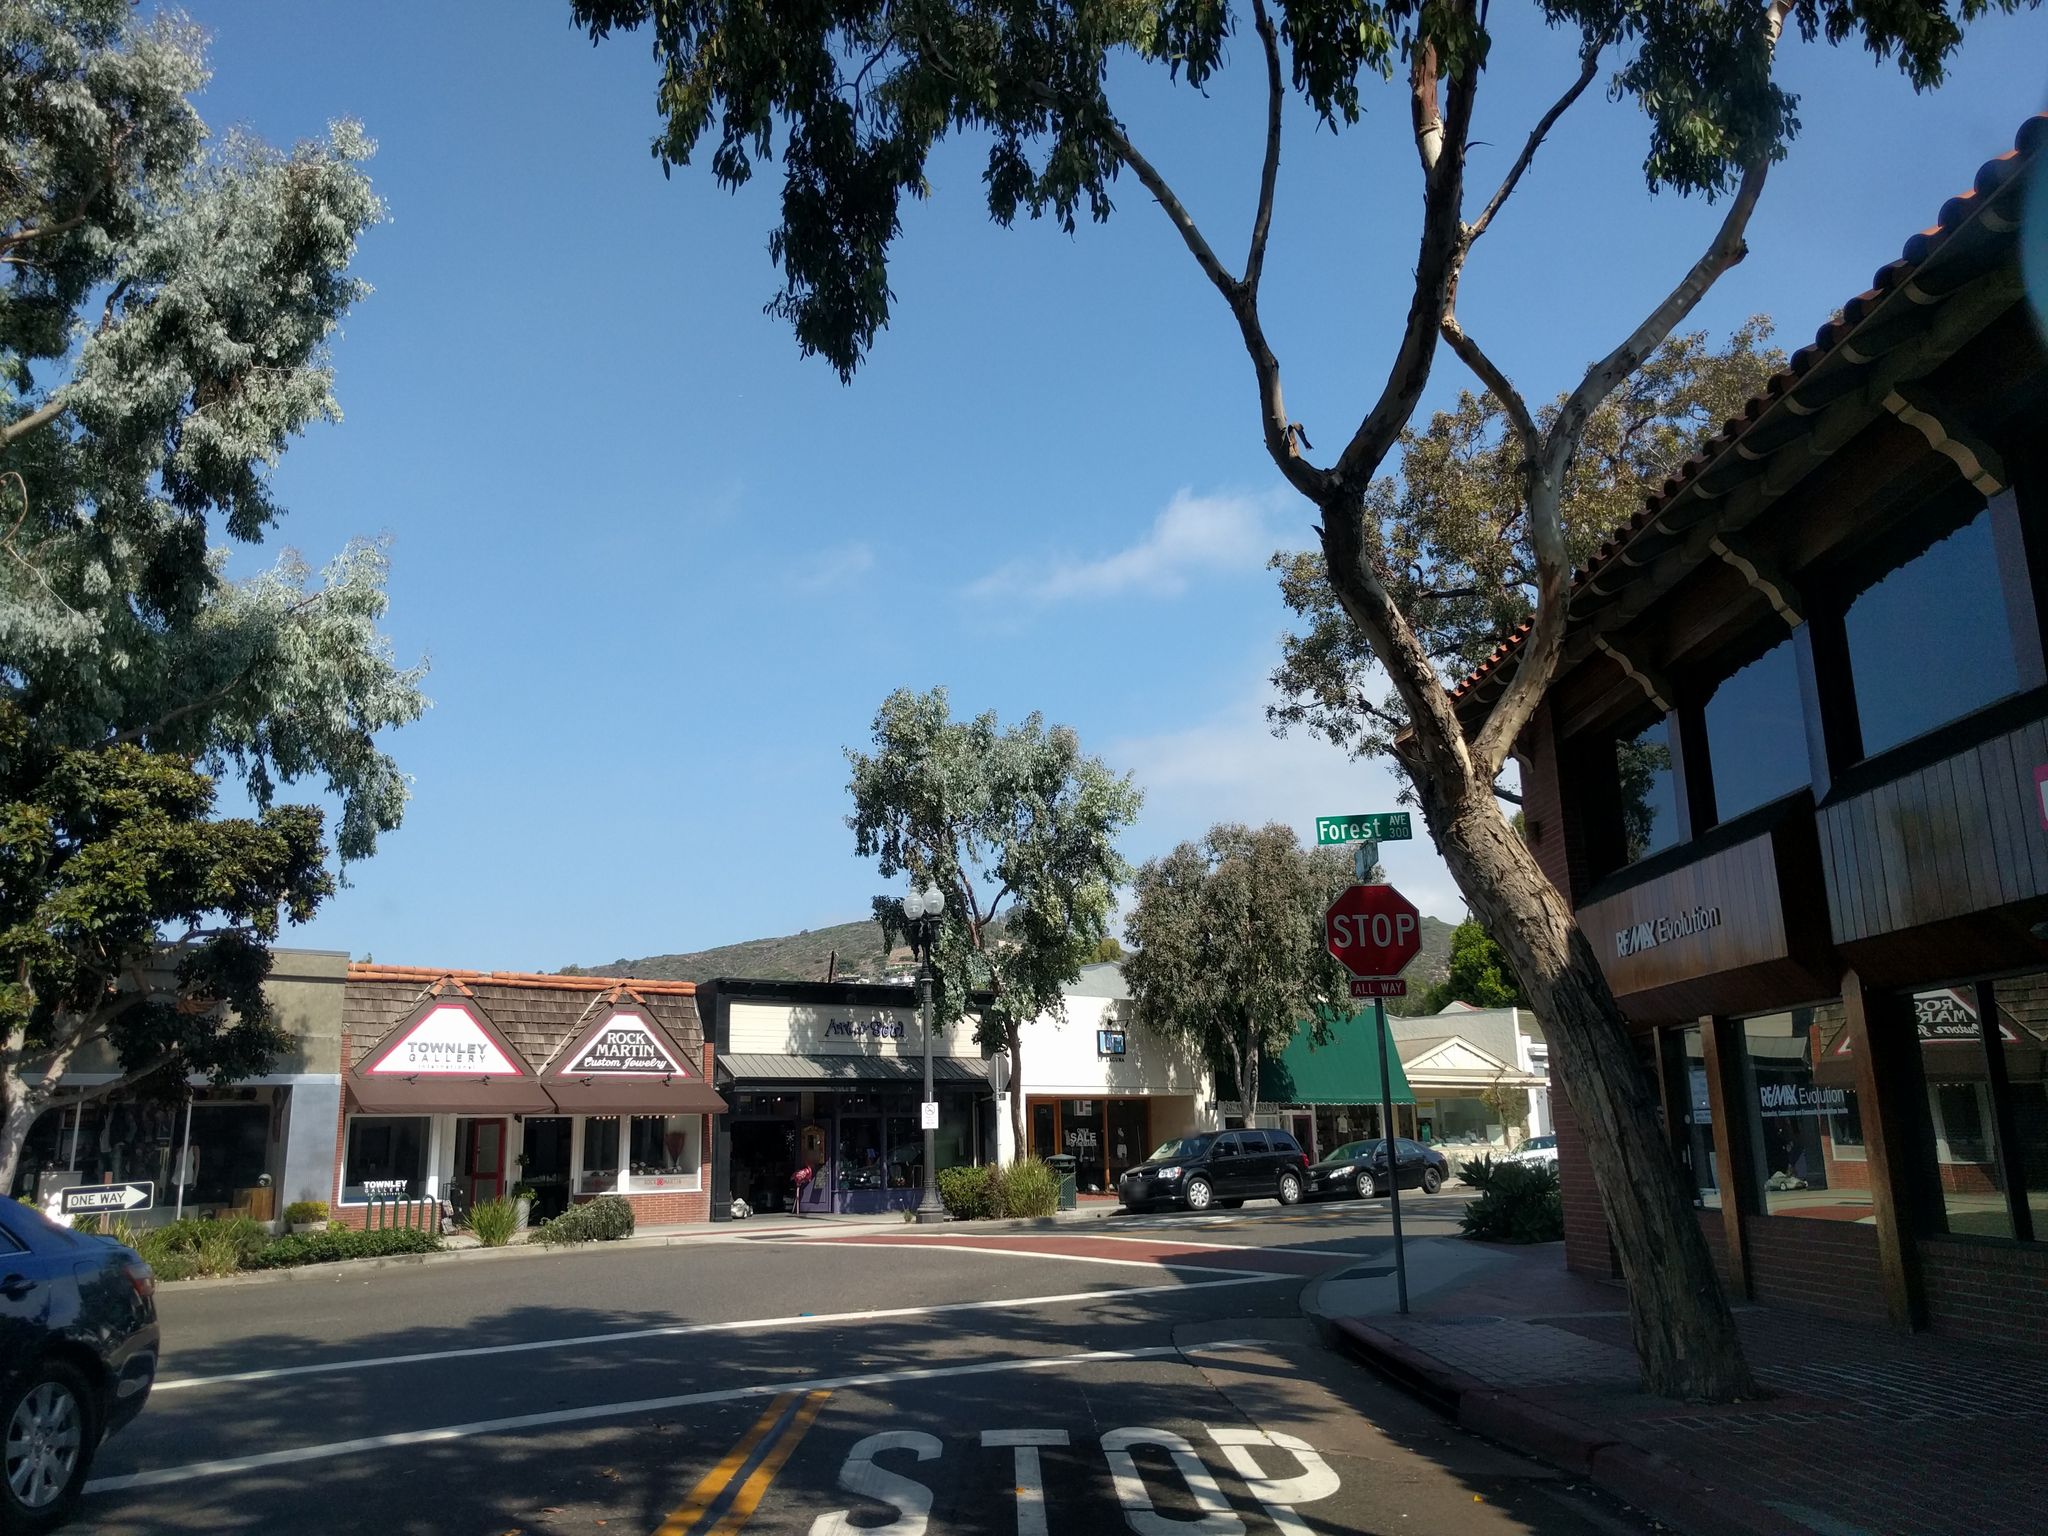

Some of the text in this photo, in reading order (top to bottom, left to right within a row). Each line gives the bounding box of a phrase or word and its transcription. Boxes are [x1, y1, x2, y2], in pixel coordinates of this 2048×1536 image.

[1319, 815, 1407, 840] Forest AVE
[1389, 827, 1409, 838] 300
[1333, 913, 1415, 948] STOP
[1615, 905, 1720, 957] RE/MAX Evolution
[1355, 982, 1402, 994] ALL WAY
[607, 1032, 646, 1045] ROCK
[407, 1042, 488, 1054] TOWNLEY
[595, 1044, 655, 1057] MARTIN
[408, 1054, 486, 1063] GALLERY
[584, 1056, 668, 1070] Custom Jewelry
[1760, 1084, 1845, 1108] RE/MAX Evolution
[1070, 1132, 1097, 1142] SALE
[363, 1180, 408, 1189] TOWNLEY
[71, 1192, 125, 1206] ONE WAY
[808, 1425, 1341, 1536] STOP
